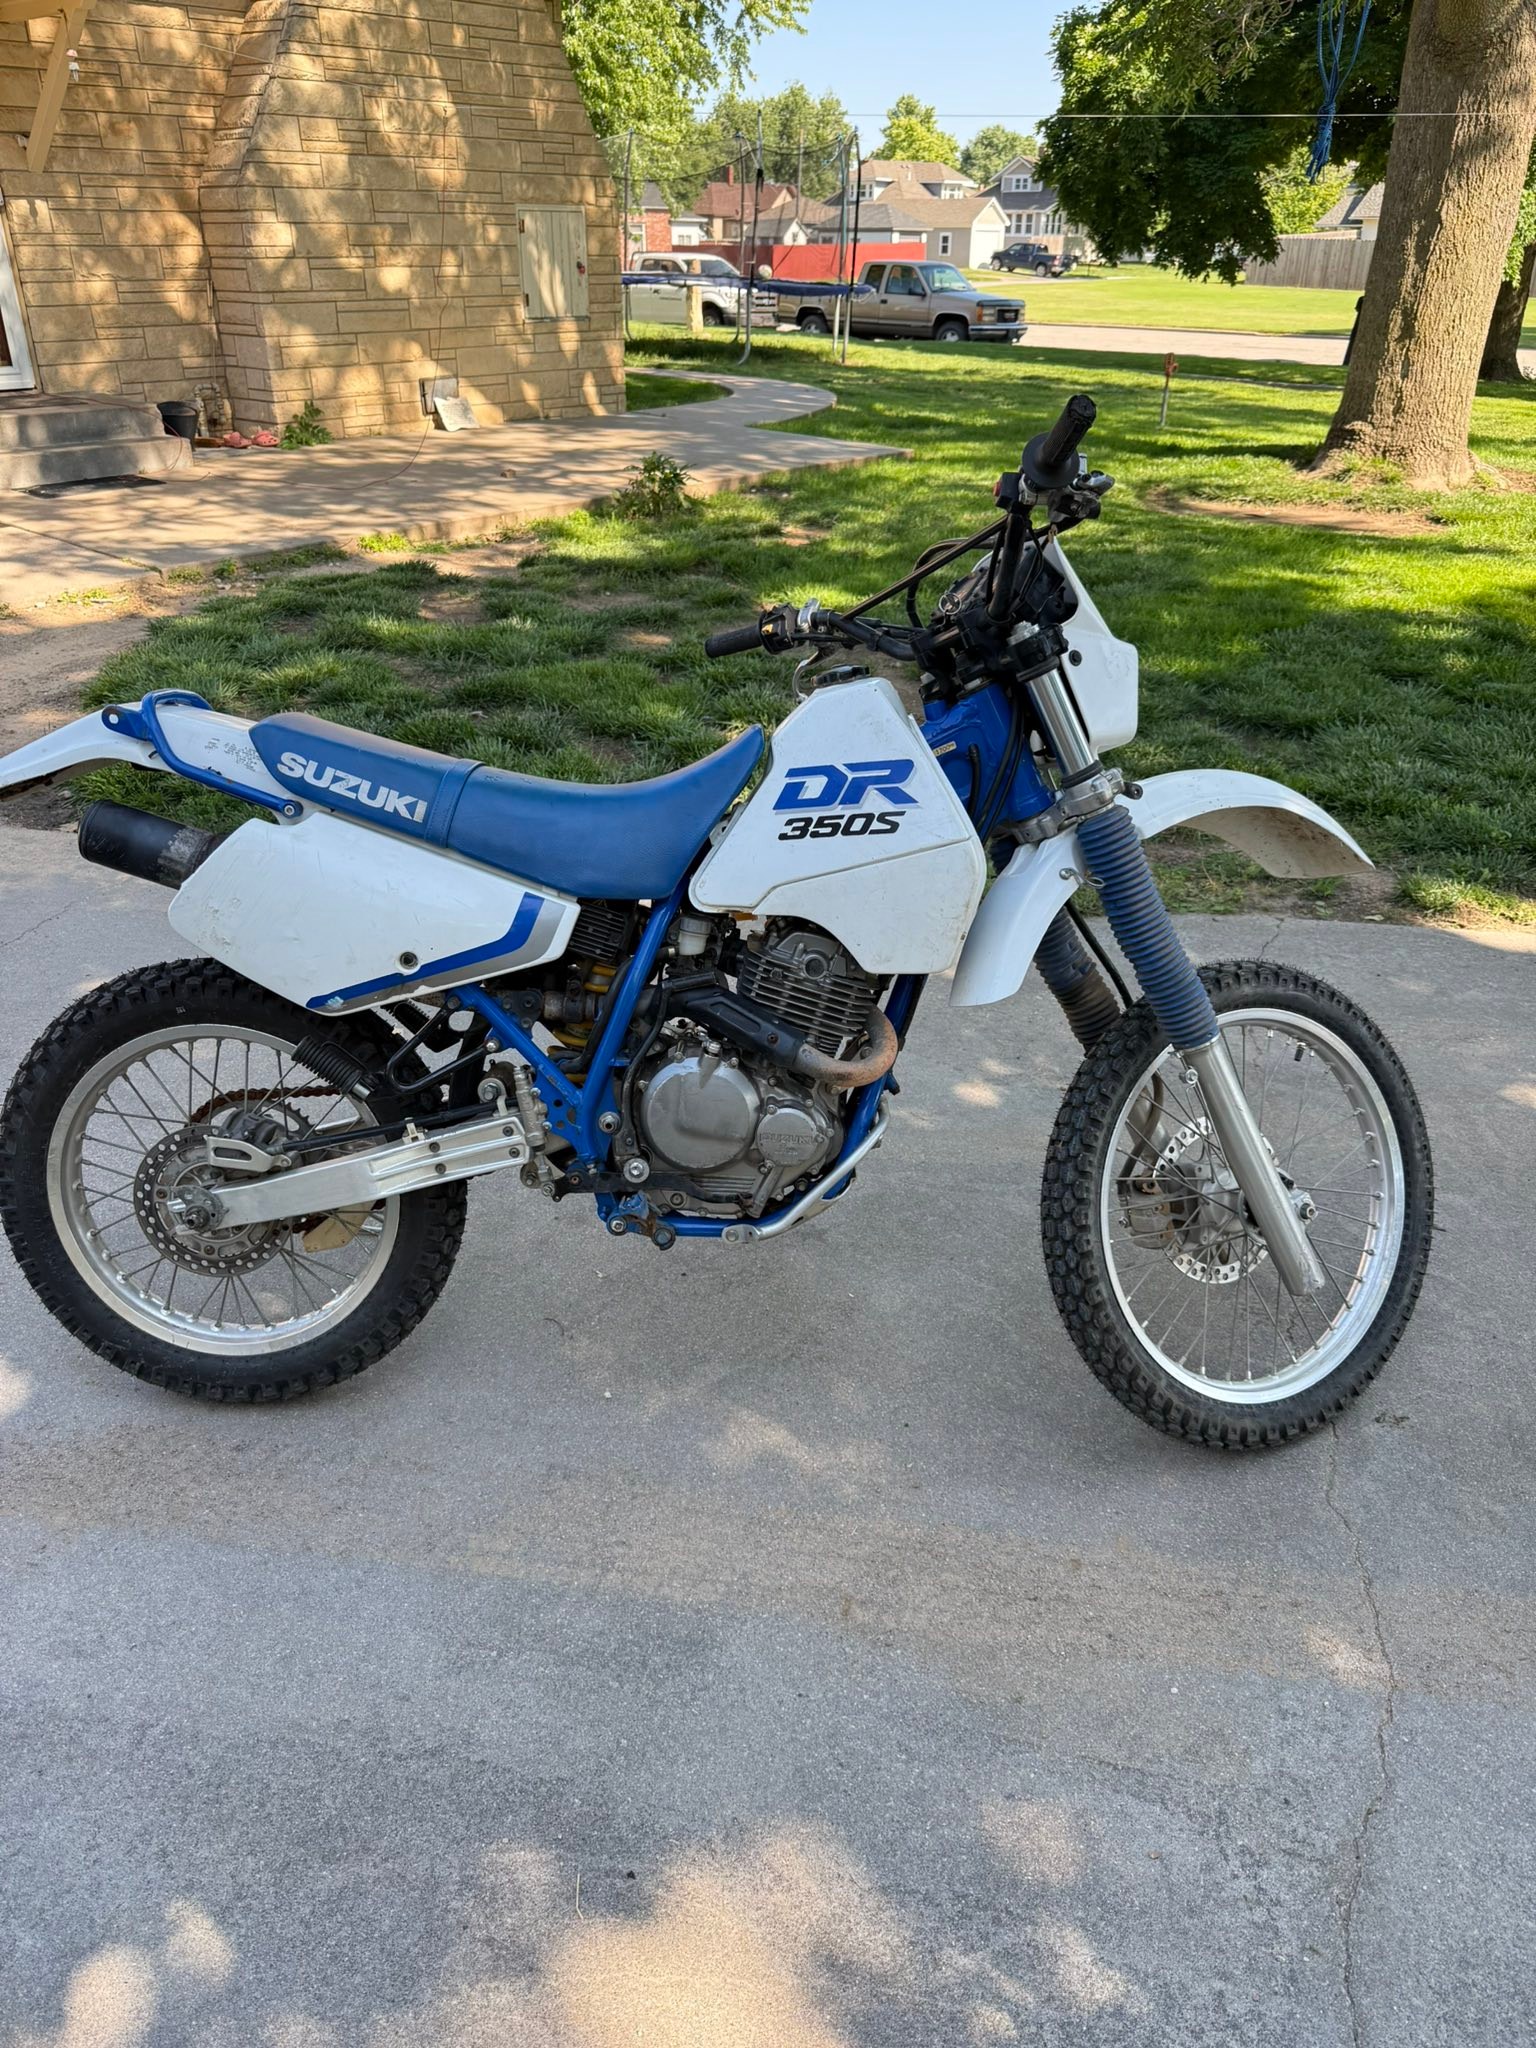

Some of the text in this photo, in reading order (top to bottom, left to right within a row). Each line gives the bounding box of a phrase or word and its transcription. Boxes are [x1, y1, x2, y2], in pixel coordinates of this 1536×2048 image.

[277, 752, 428, 823] SUZUKI
[773, 759, 921, 813] DR
[778, 811, 906, 841] 350S
